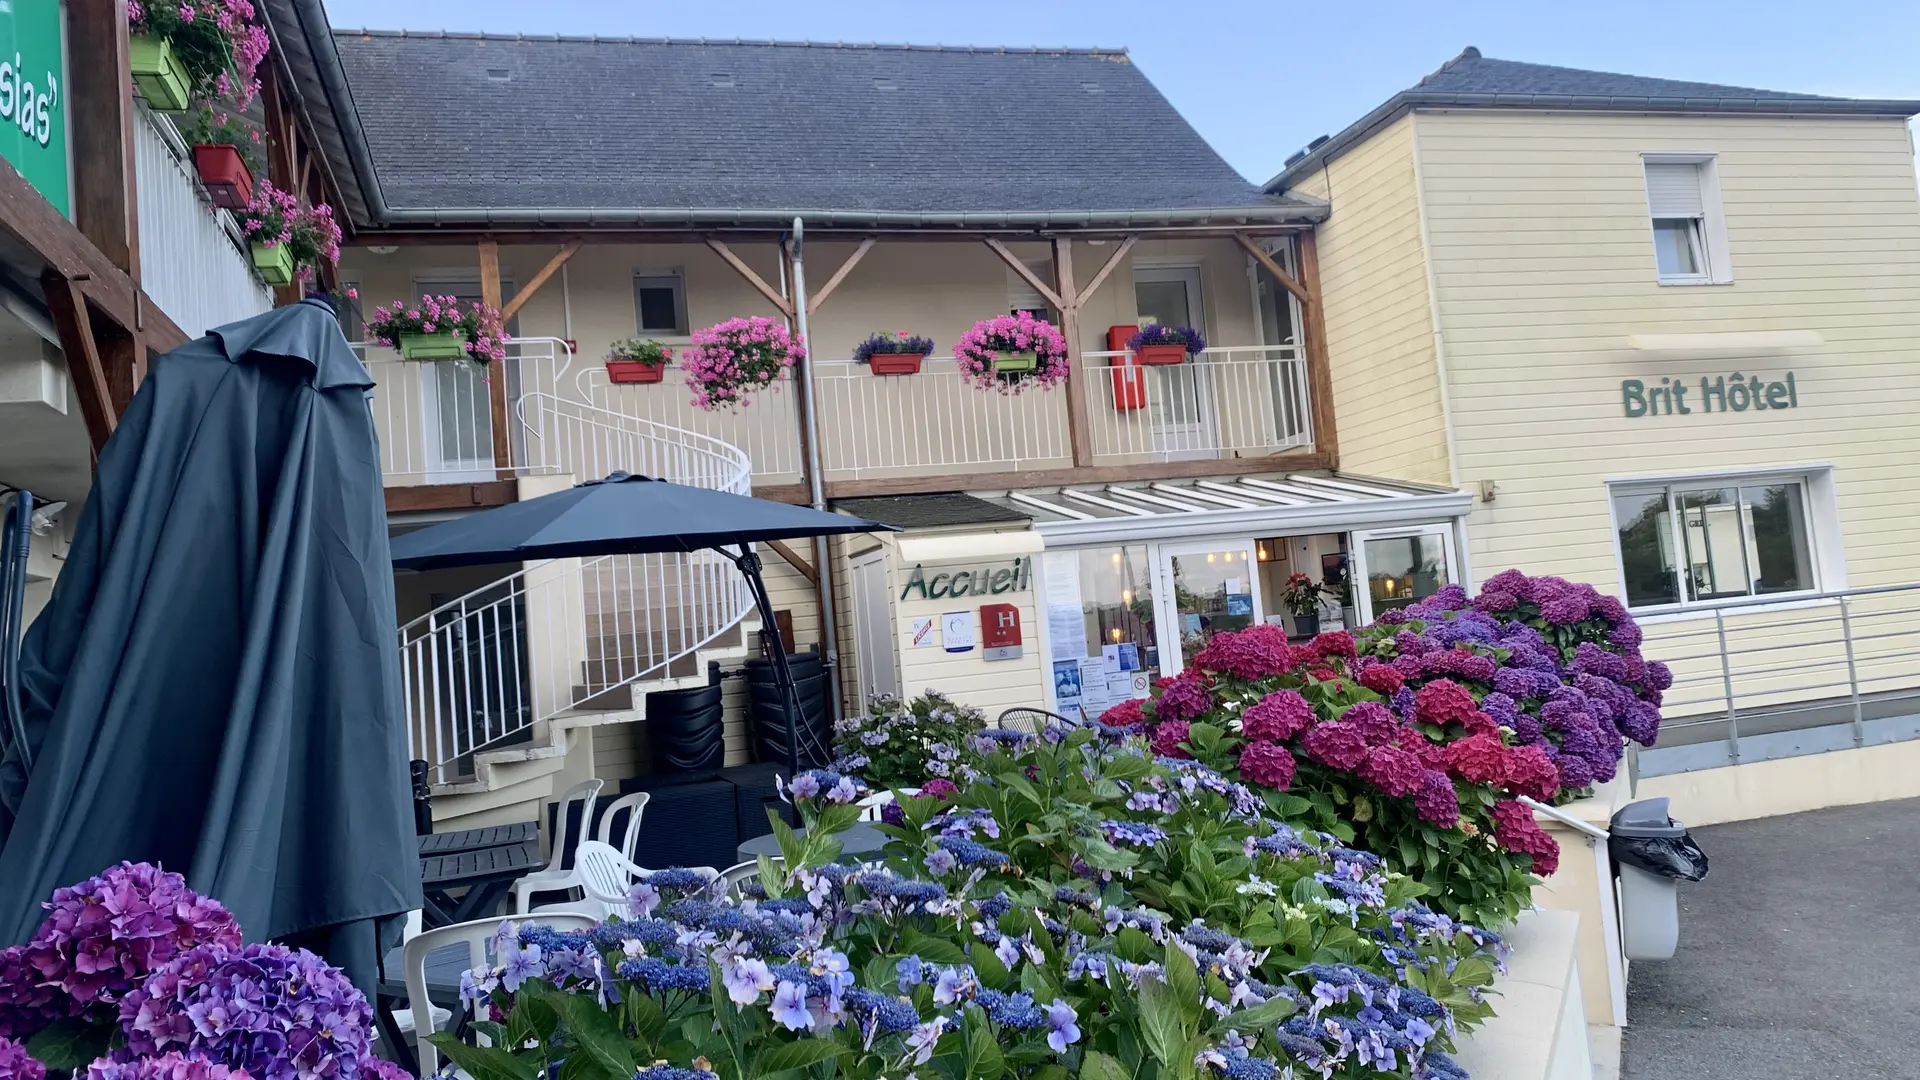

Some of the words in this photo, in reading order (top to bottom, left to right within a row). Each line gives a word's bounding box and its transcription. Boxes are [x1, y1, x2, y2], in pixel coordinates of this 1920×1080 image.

[1622, 376, 1691, 417] Brit
[1702, 371, 1798, 413] Hôtel
[900, 556, 1031, 601] Accueil
[998, 610, 1016, 628] H
